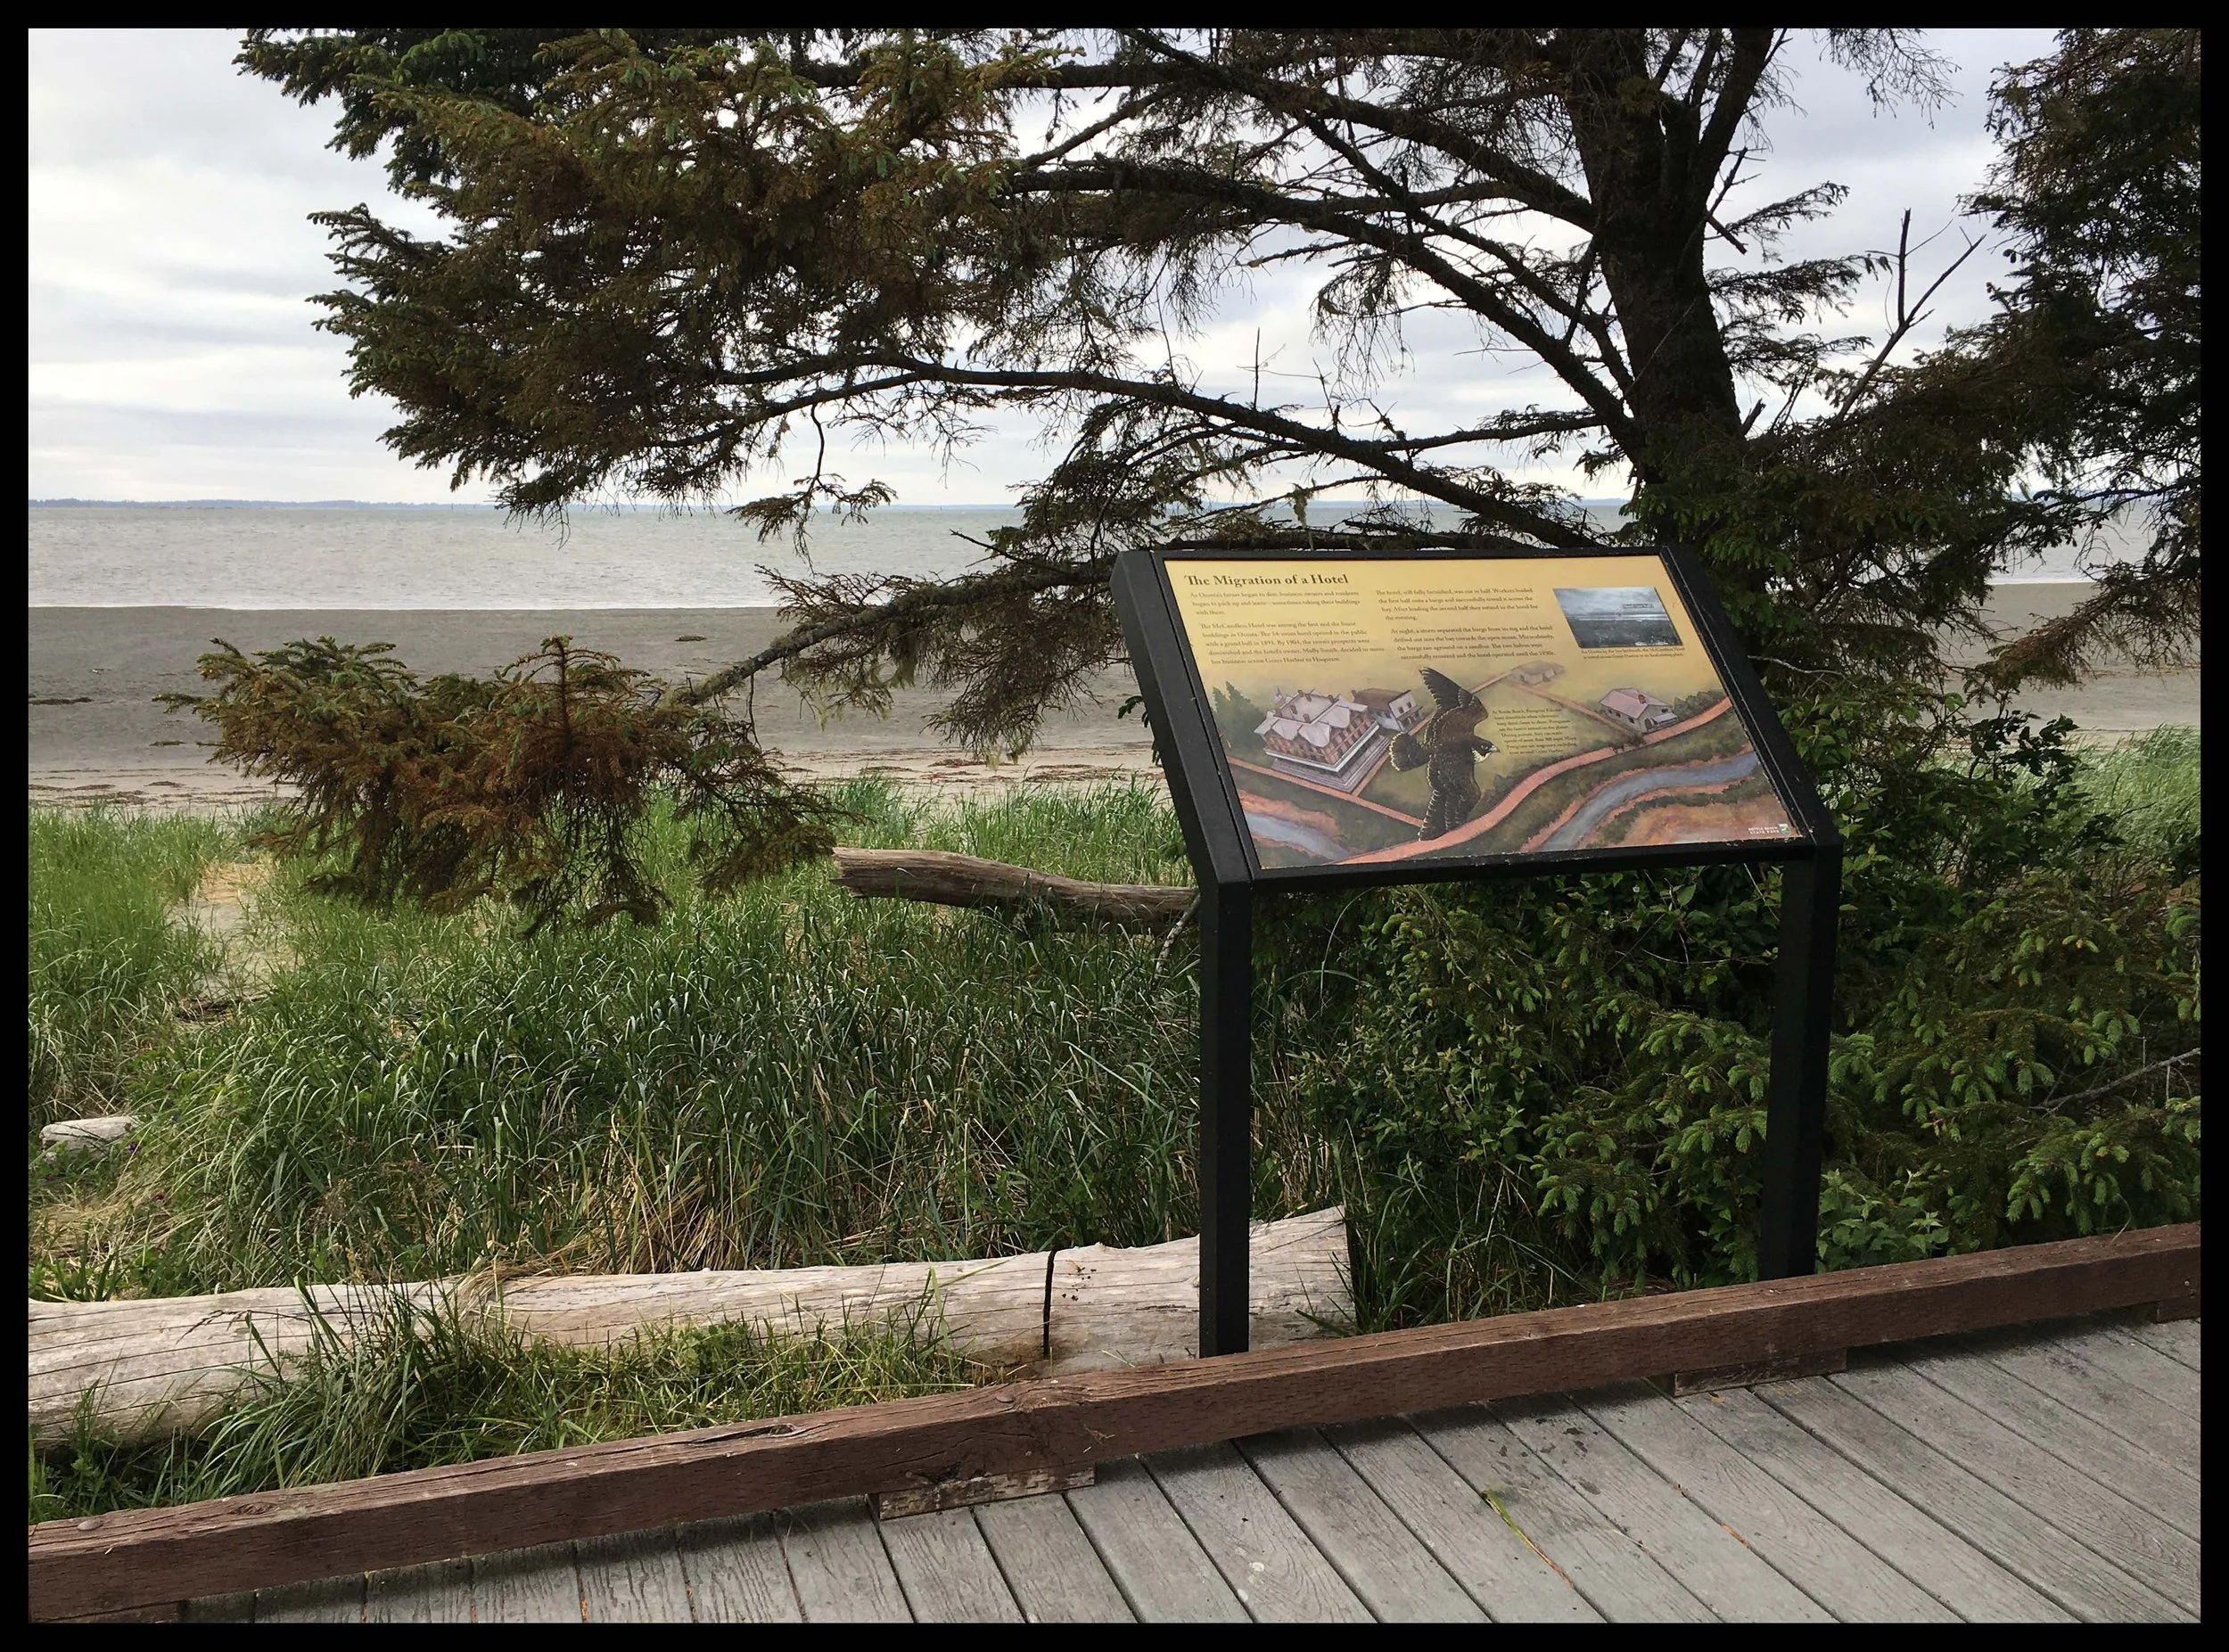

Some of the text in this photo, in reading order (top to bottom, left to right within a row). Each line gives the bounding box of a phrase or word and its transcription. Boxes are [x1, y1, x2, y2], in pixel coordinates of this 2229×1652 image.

[1184, 574, 1211, 586] The
[1213, 574, 1281, 588] Migration
[1285, 573, 1298, 585] of
[1311, 573, 1349, 584] Hotel
